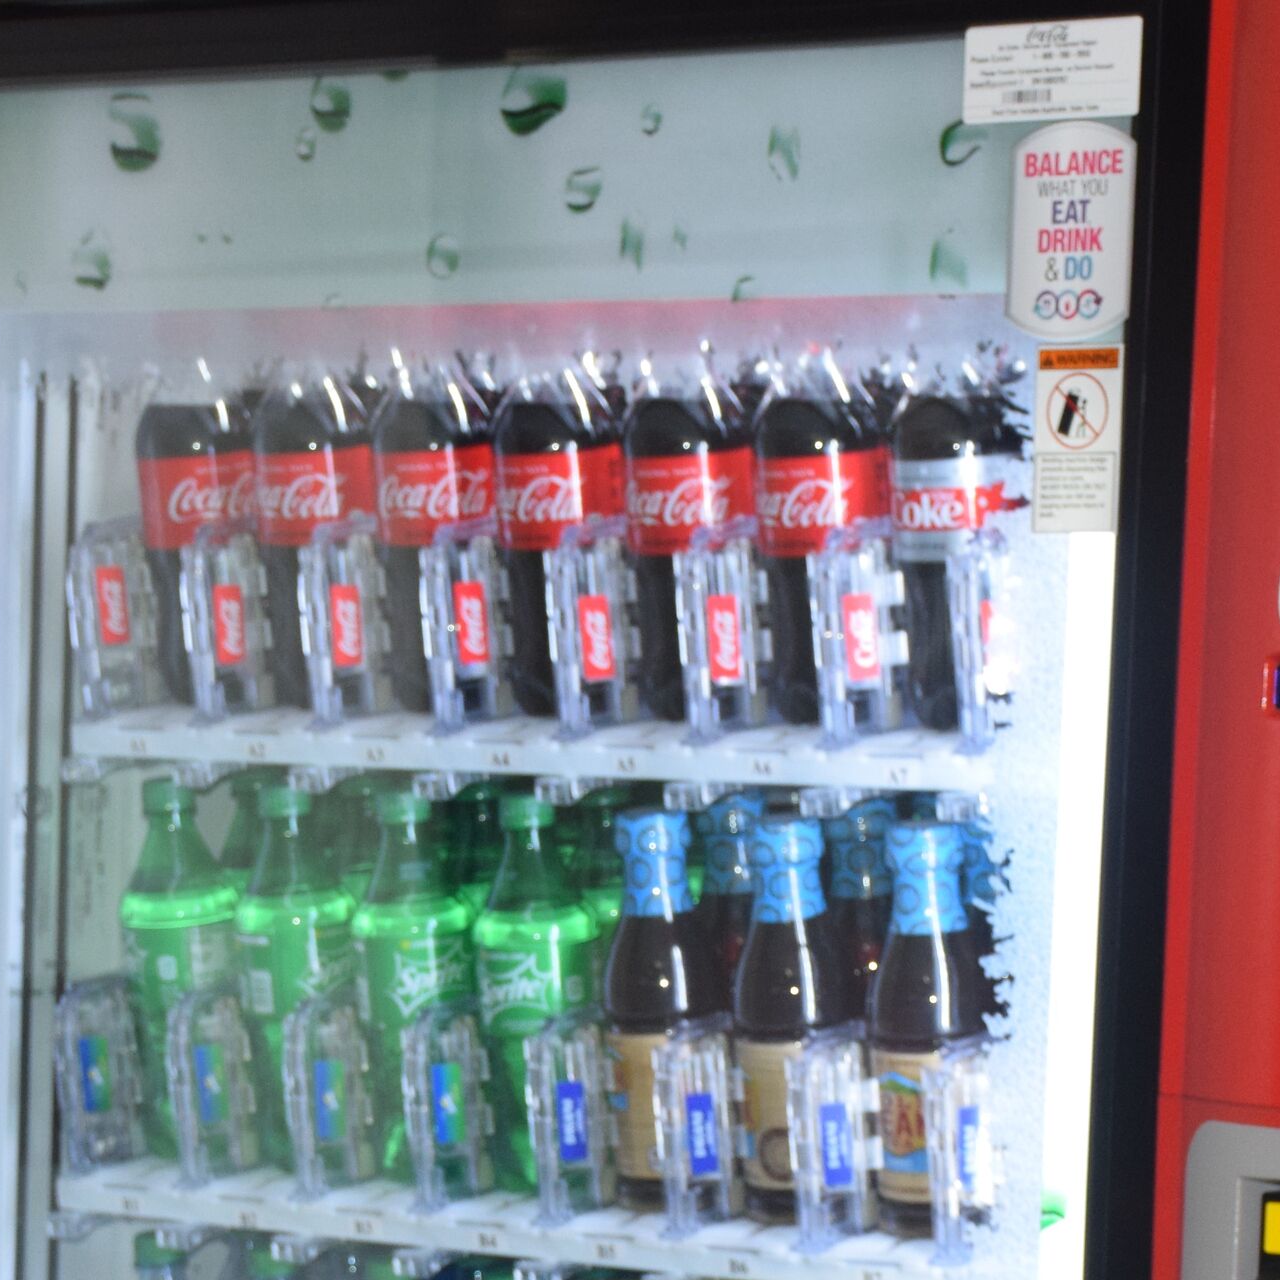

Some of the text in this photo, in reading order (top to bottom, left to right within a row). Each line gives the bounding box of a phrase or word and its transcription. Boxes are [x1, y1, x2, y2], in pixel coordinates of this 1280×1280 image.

[1023, 149, 1124, 177] BALANCE
[1037, 178, 1109, 197] WHAT YOU
[1051, 199, 1091, 225] EAT
[1038, 227, 1104, 254] DRINK
[1044, 256, 1093, 282] & DO
